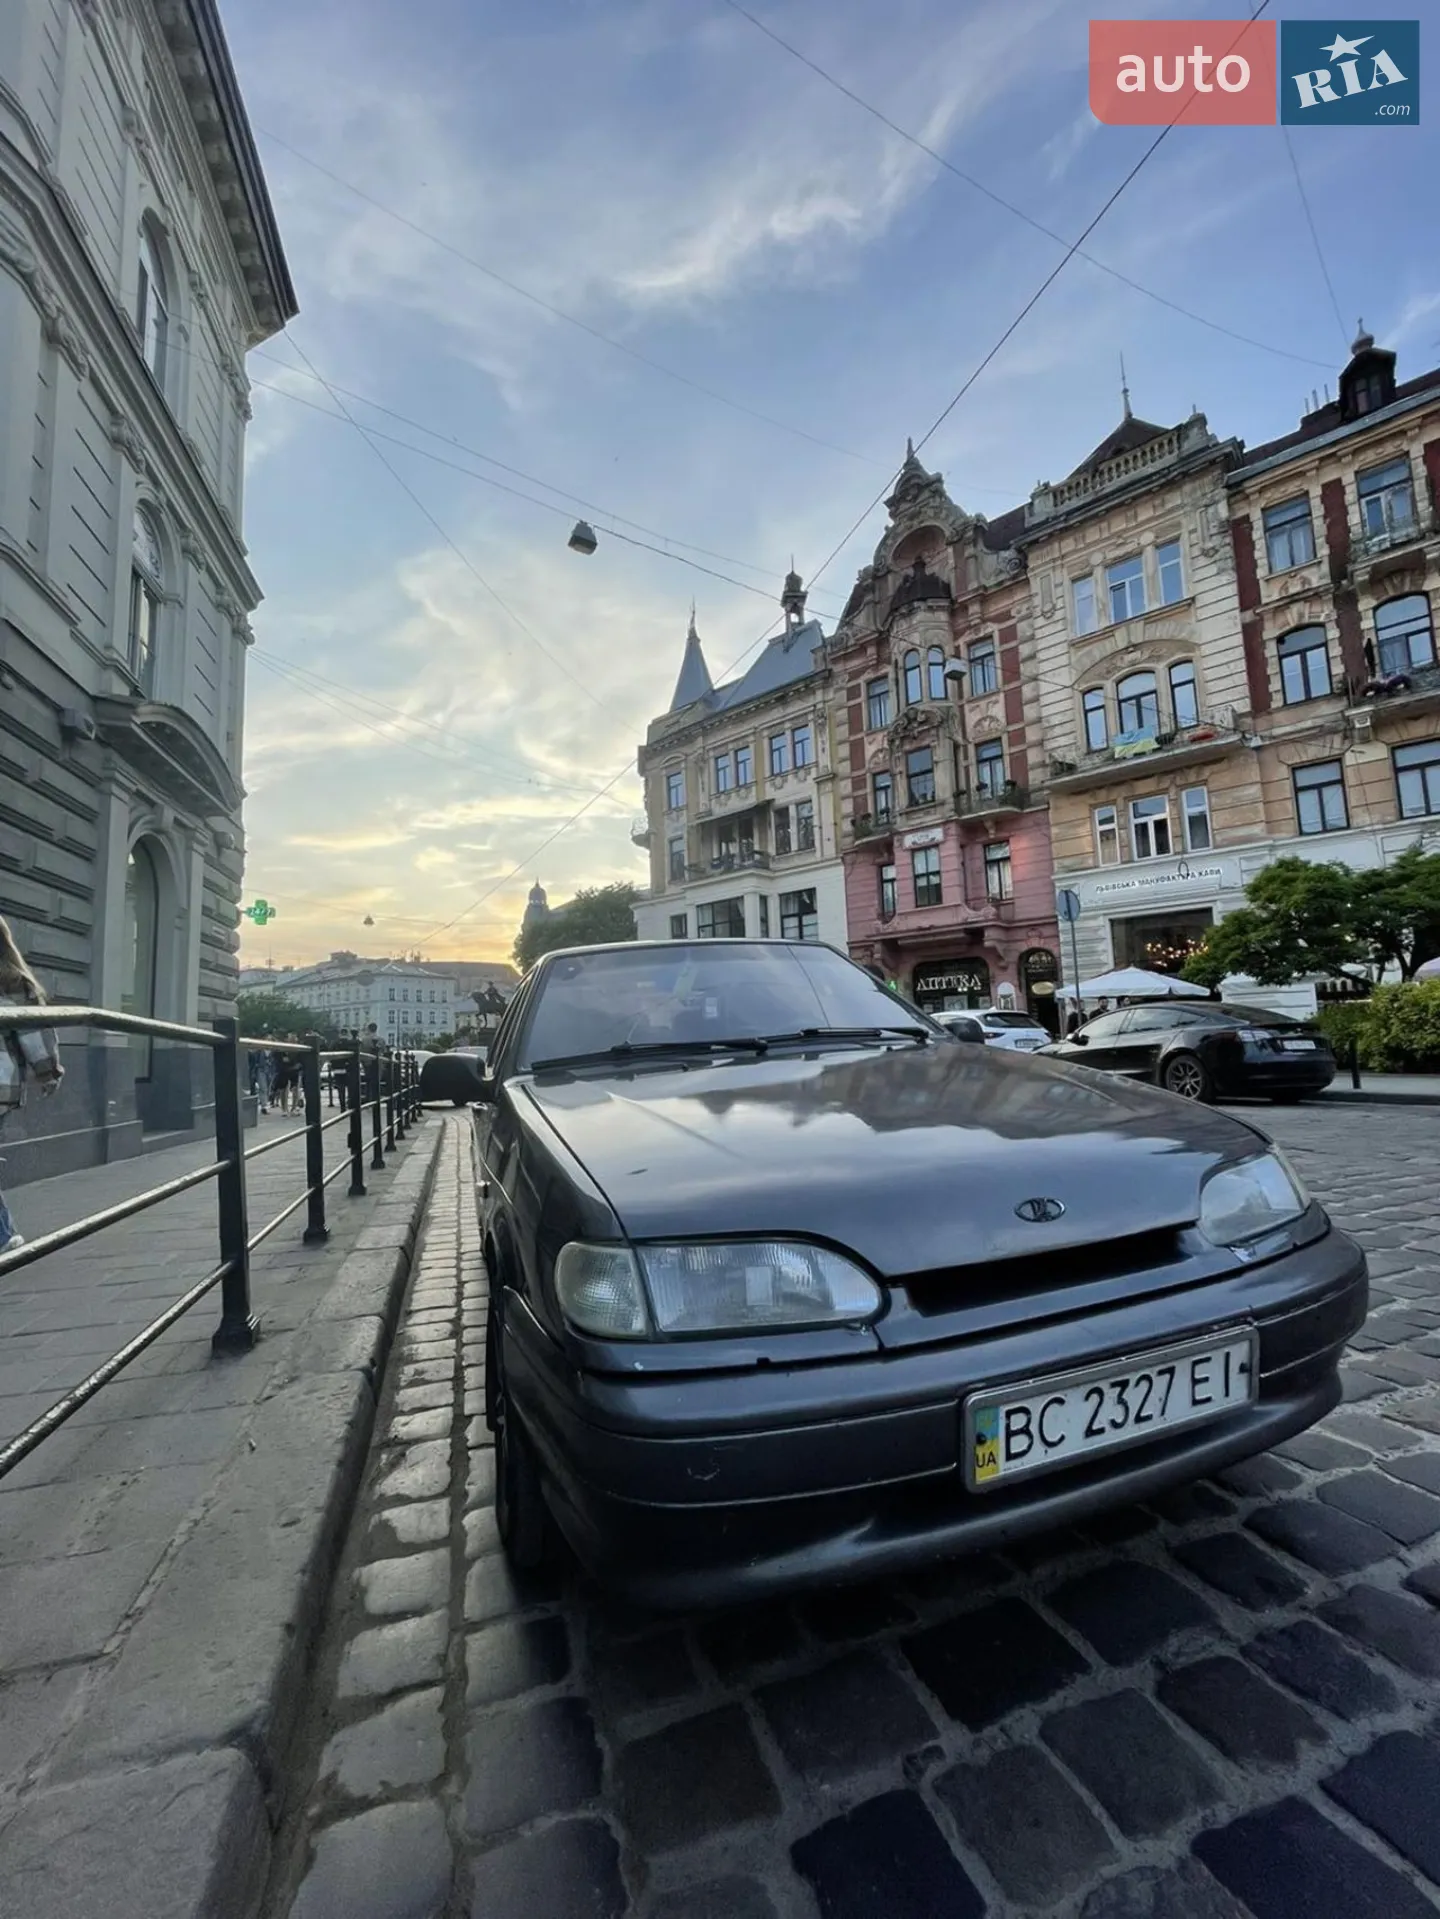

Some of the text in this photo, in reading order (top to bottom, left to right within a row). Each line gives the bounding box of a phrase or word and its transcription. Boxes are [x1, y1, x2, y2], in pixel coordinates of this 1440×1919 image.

[1199, 868, 1222, 878] КАВИ
[1004, 1351, 1231, 1462] BC 2327 EI
[976, 1454, 997, 1468] UA
